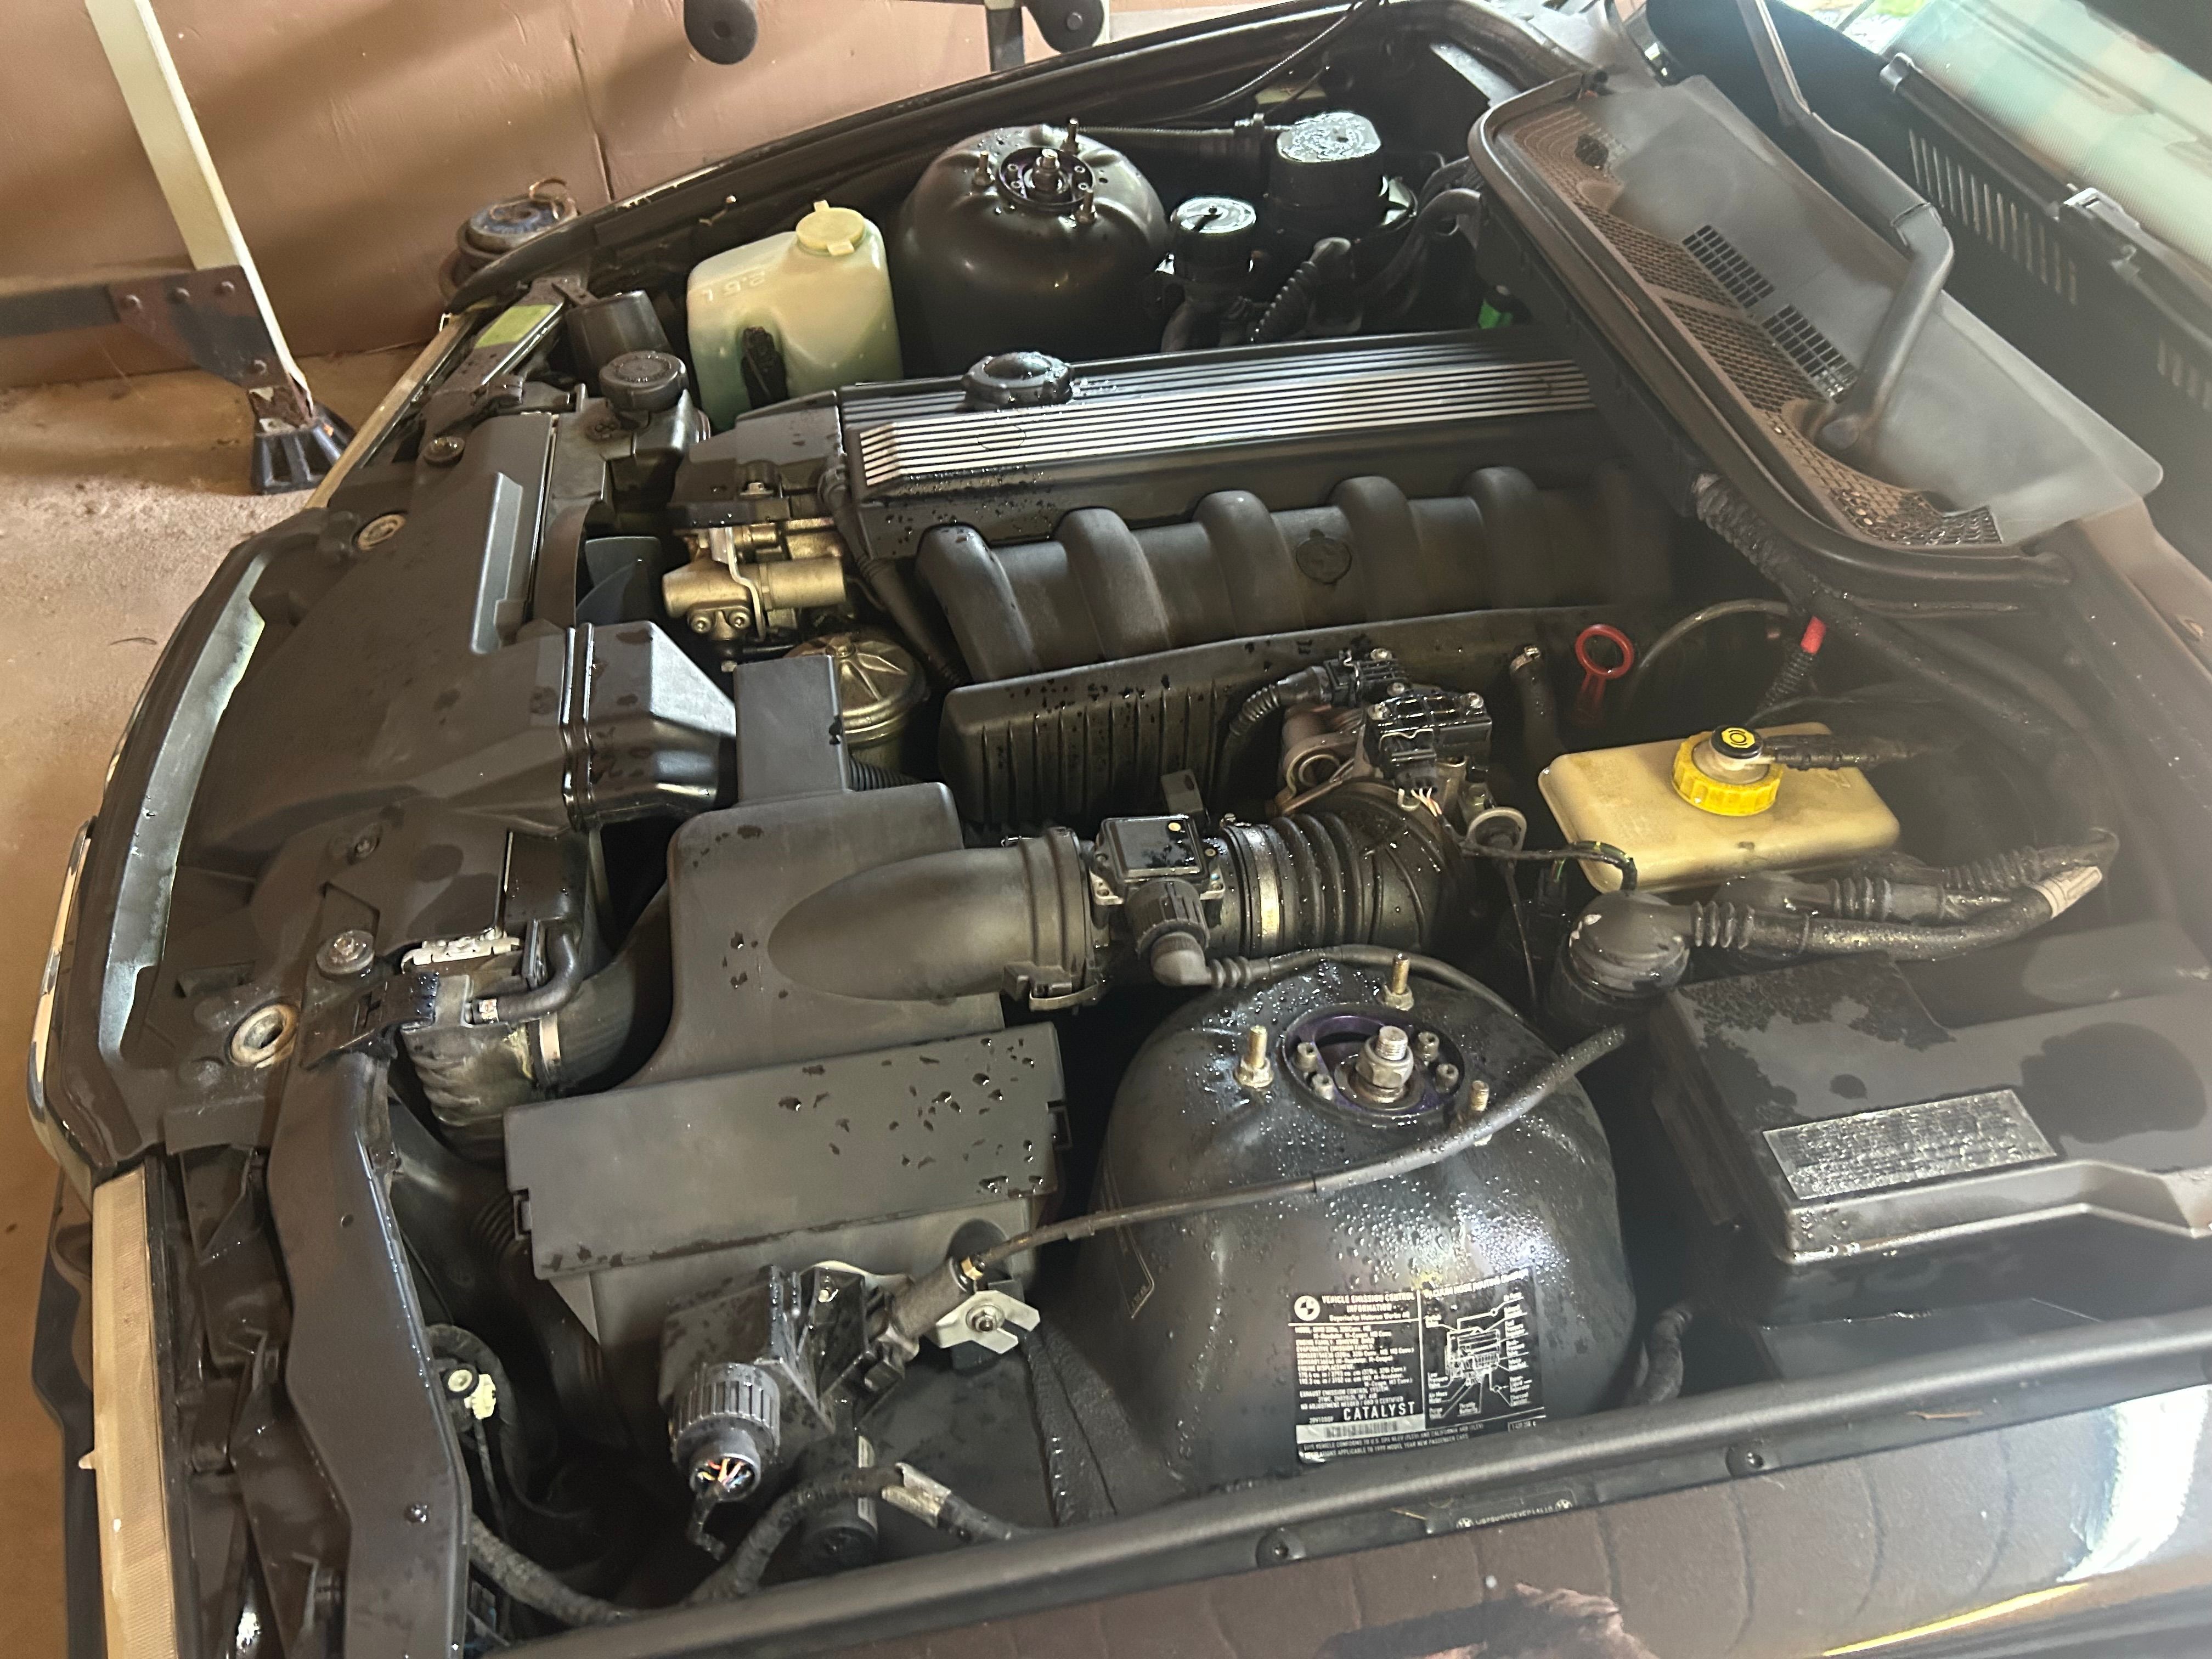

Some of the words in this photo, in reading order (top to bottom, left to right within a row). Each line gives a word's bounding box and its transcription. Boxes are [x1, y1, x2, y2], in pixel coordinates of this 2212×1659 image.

[1322, 1295, 1350, 1304] VEHICLE
[1351, 1294, 1384, 1303] EMISSION
[1385, 1292, 1415, 1302] CONTROL
[1346, 1303, 1392, 1313] INFORMATION
[1344, 1401, 1415, 1421] CATALYST
